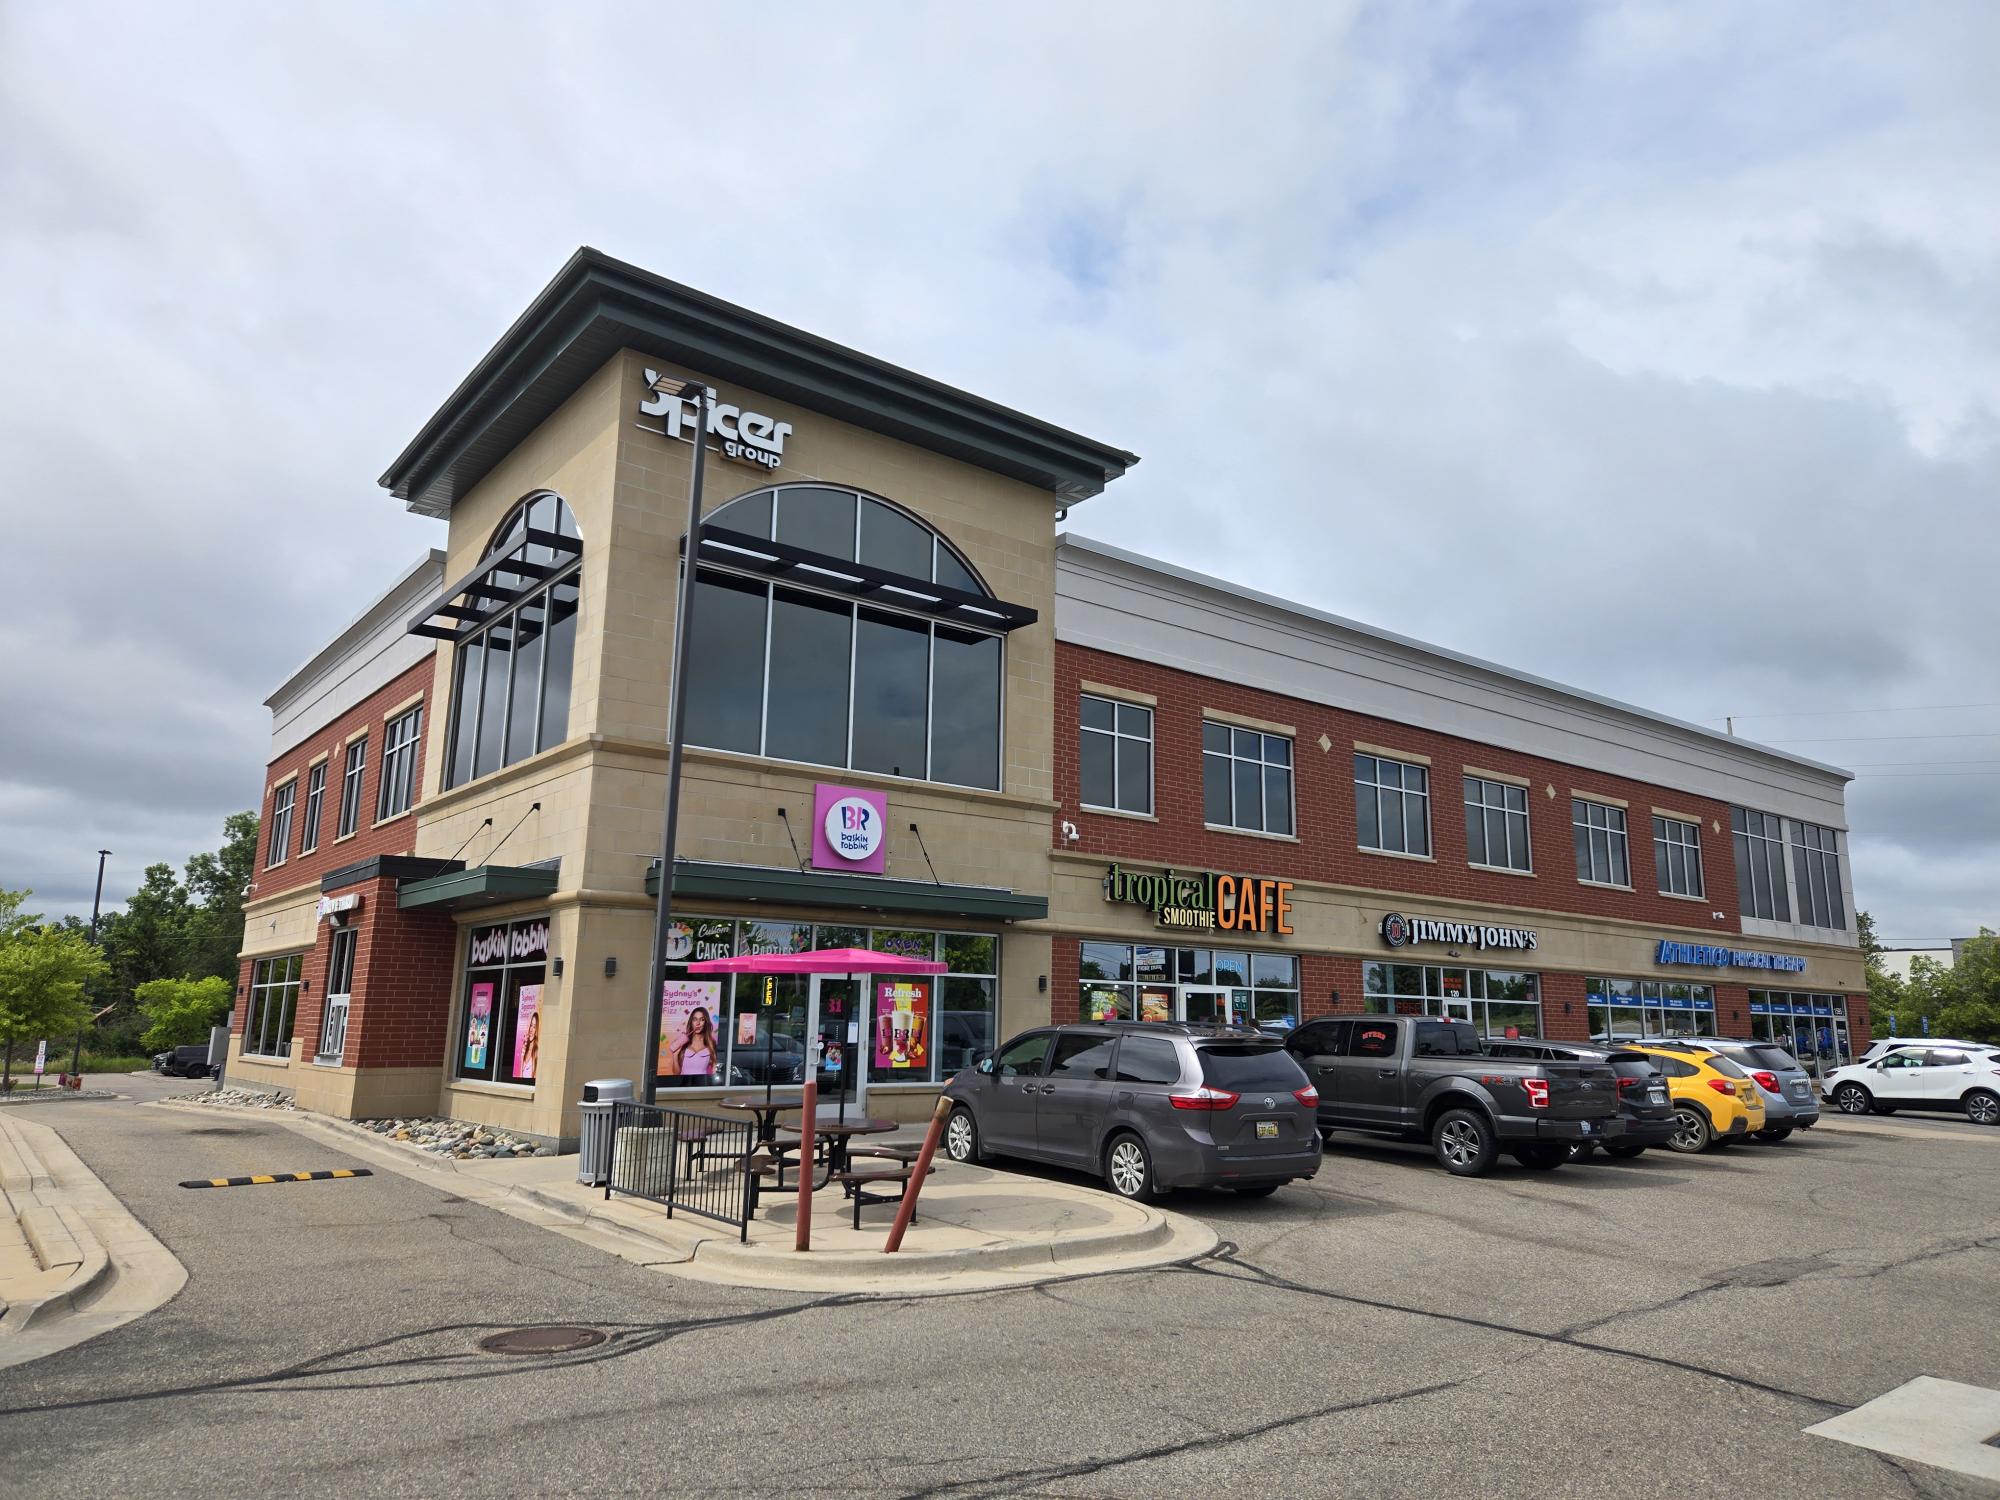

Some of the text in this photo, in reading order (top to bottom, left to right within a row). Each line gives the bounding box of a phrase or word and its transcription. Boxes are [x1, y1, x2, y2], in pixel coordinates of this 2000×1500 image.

[723, 440, 781, 469] group
[841, 805, 870, 831] BR
[841, 832, 868, 843] baskin
[841, 841, 868, 851] robbins
[1109, 862, 1214, 912] tropical
[1217, 874, 1294, 935] CAFE
[1163, 906, 1216, 929] SMOOTHIE
[471, 923, 549, 965] baskin robbin
[884, 937, 922, 951] OPEN
[1411, 918, 1478, 945] JIMMY
[1479, 925, 1538, 951] JOHN'S
[696, 940, 730, 960] CAKES
[1660, 939, 1809, 972] ATHLETICO PHYSICAL THERAPY
[1216, 959, 1242, 973] OPEN
[663, 989, 698, 998] Sydney's
[663, 999, 701, 1007] Signature
